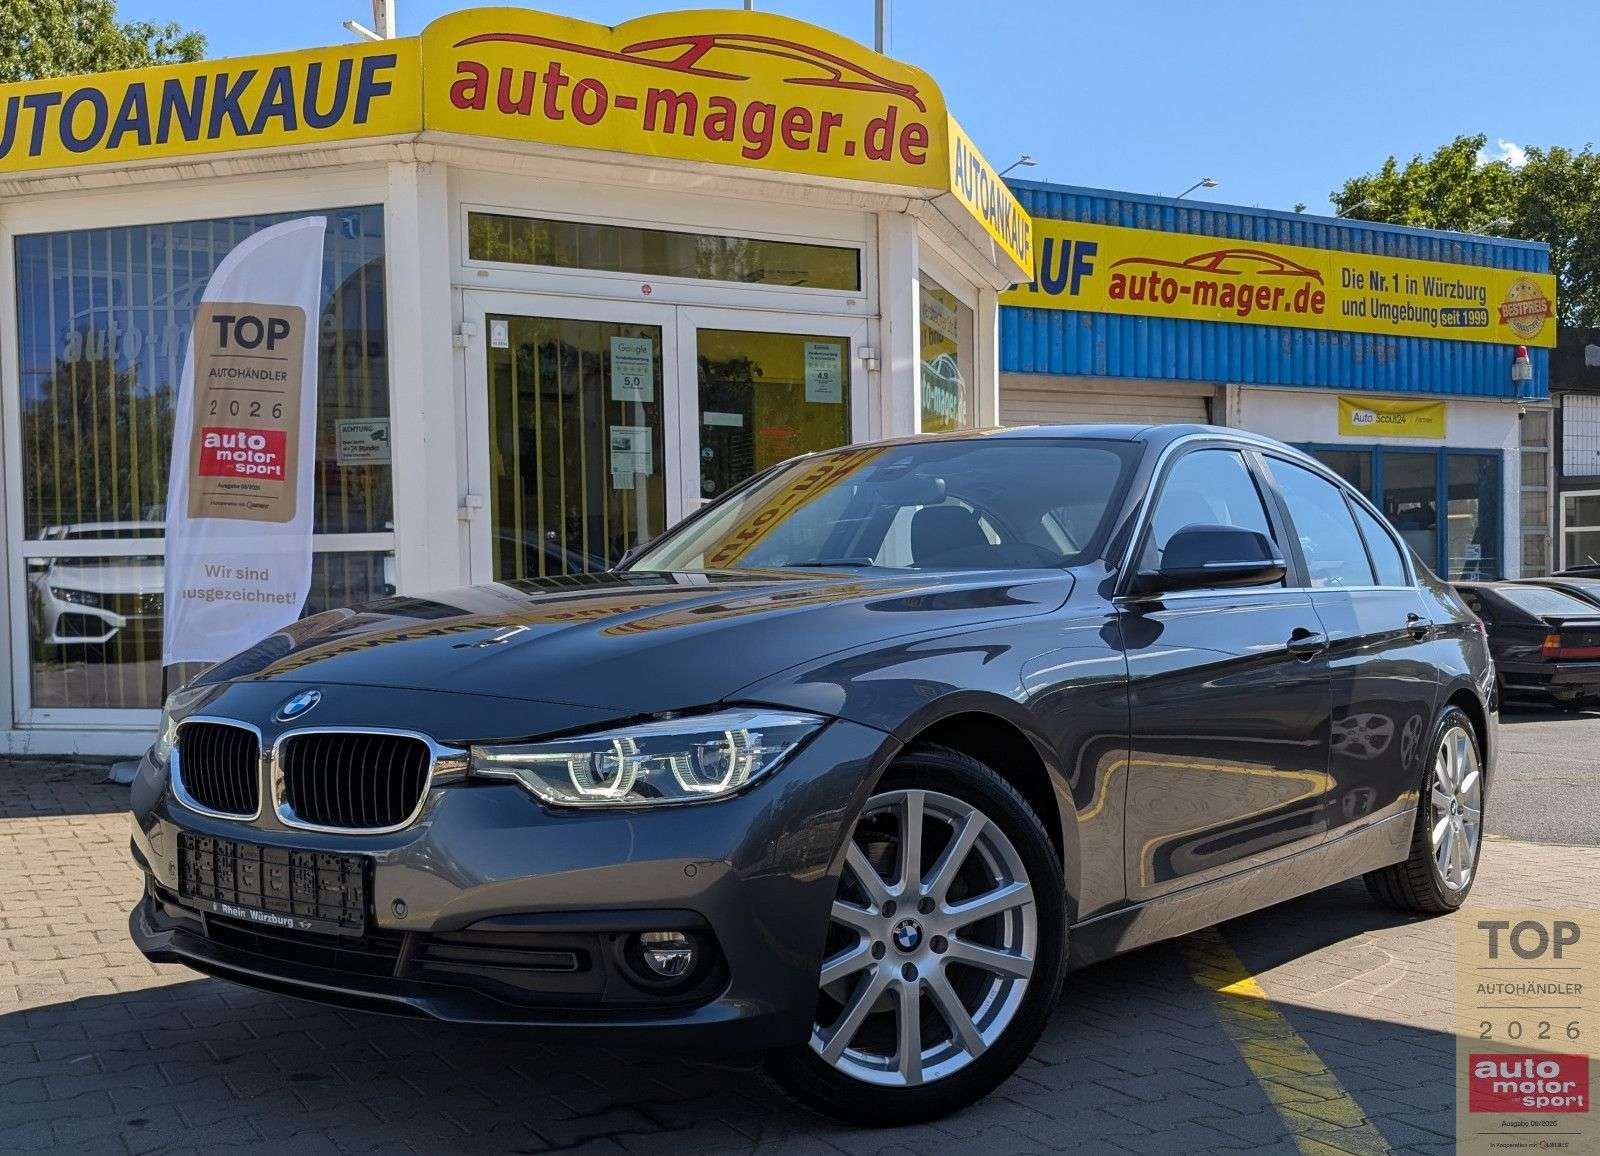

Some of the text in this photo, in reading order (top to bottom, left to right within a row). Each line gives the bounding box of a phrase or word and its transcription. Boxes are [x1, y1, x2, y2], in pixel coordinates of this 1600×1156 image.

[449, 60, 929, 166] auto-mager.de
[955, 136, 1029, 265] AUTOANKAUF
[1109, 271, 1326, 316] auto-mager.de
[1341, 267, 1486, 305] Die Nr. 1 in Würzburg
[1342, 297, 1487, 327] und Umgebung seit 1999
[1501, 298, 1549, 318] BESTPREIS
[212, 315, 291, 351] TOP
[208, 366, 288, 383] AUTOHÄNDLER
[204, 432, 266, 450] auto
[216, 450, 276, 463] motor
[235, 463, 281, 476] sport
[204, 564, 270, 582] Wir sind
[222, 904, 294, 928] Rhein Würzburg
